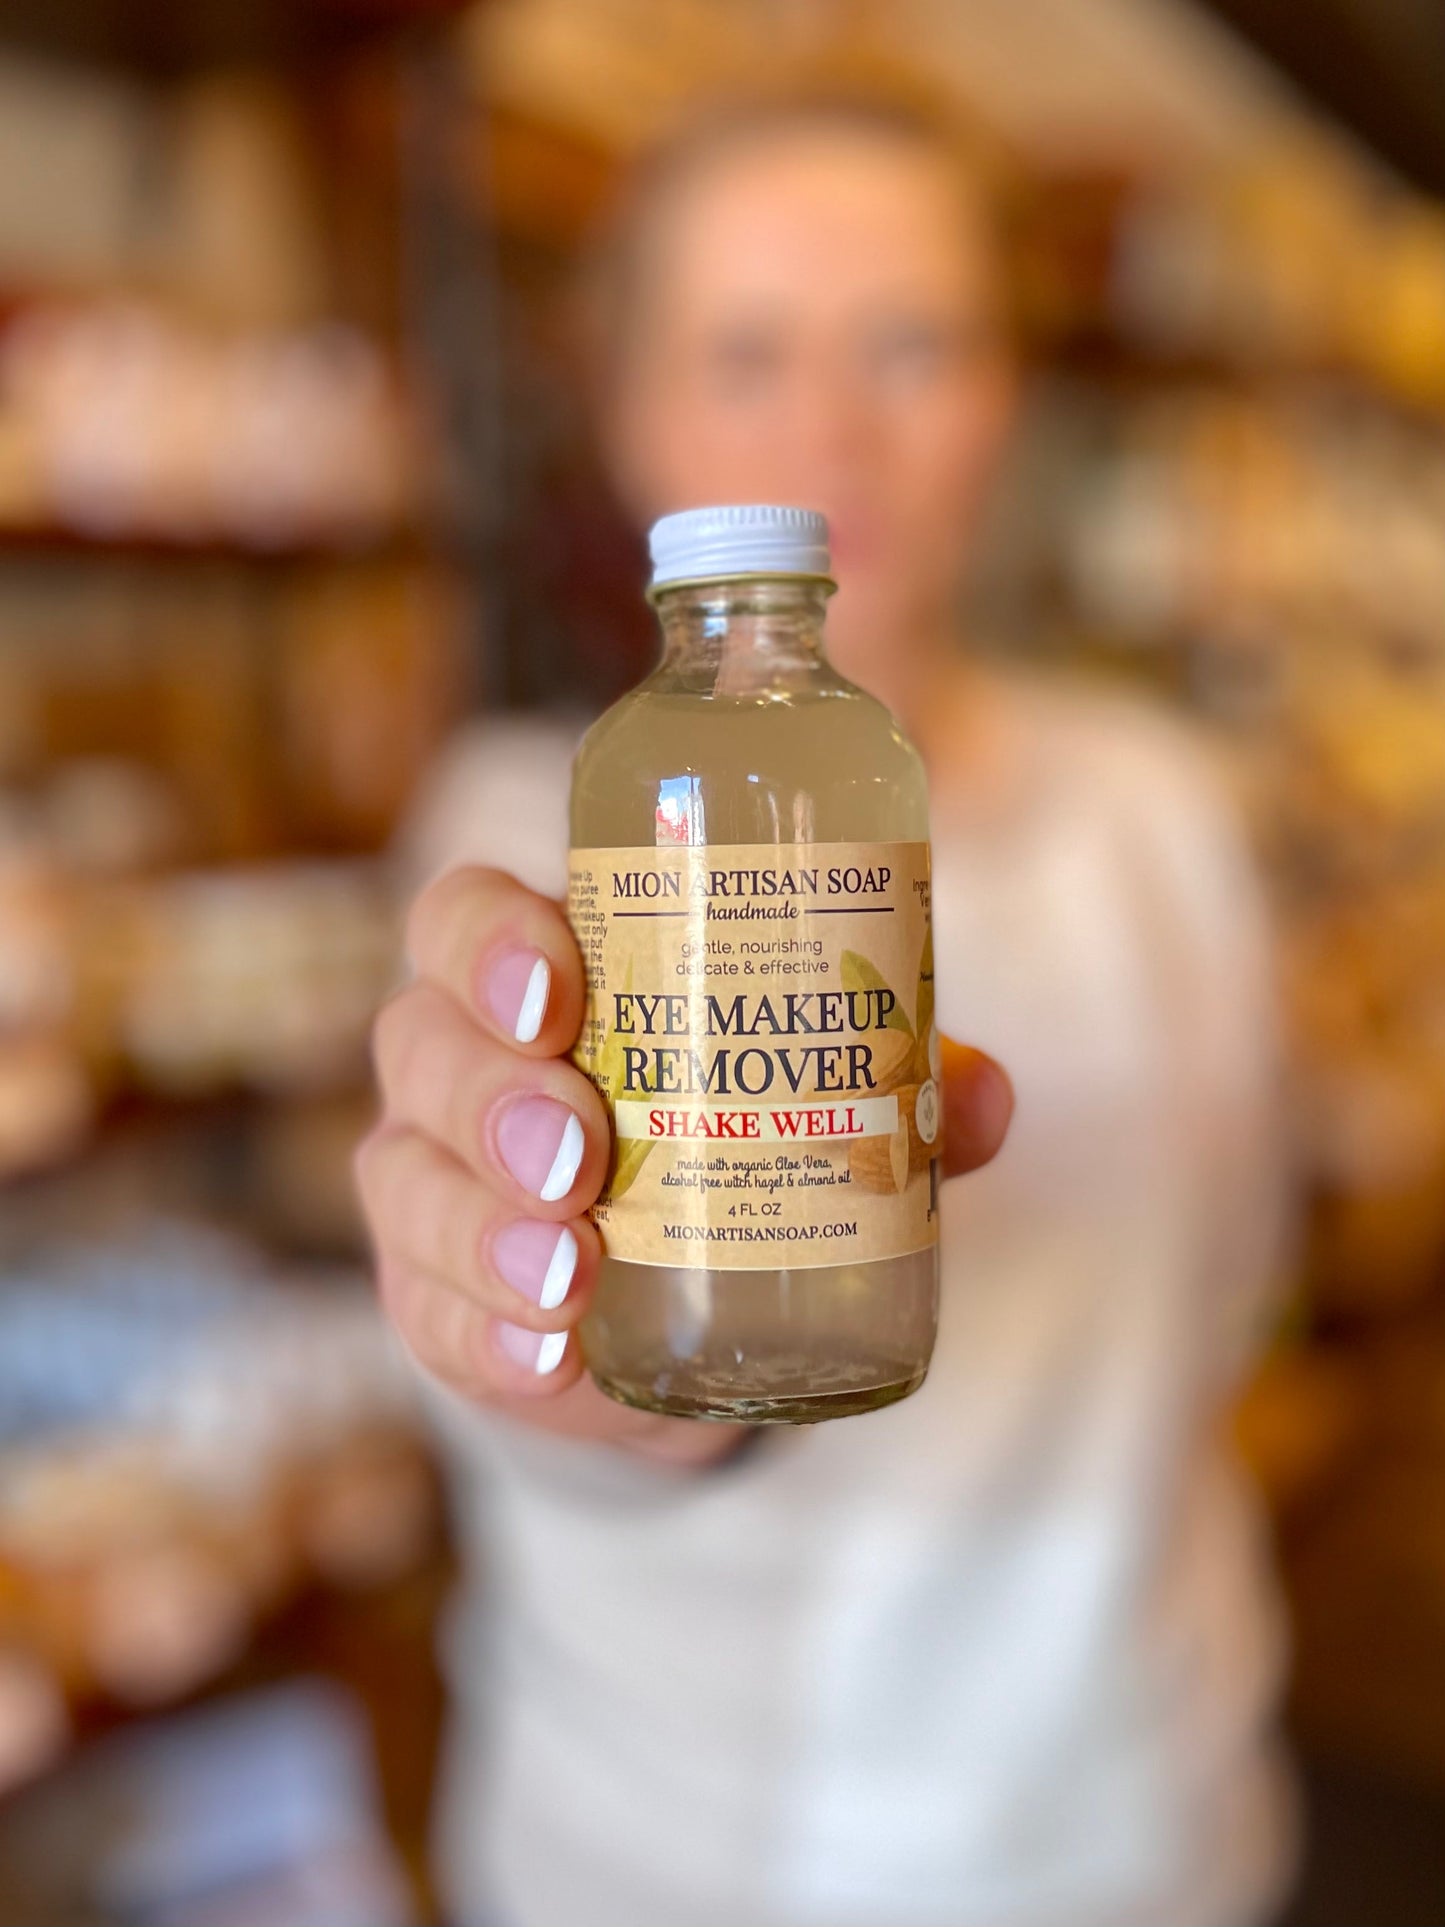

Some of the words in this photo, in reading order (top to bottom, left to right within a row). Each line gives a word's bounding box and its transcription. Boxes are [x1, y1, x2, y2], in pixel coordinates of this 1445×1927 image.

[613, 870, 681, 897] MION
[689, 869, 819, 897] ARTISAN
[827, 867, 891, 894] SOAP
[706, 901, 799, 920] handmade
[740, 938, 823, 957] nourishing
[744, 961, 756, 975] &
[758, 959, 829, 975] effective
[613, 992, 690, 1036] EYE
[704, 988, 896, 1037] MAKEUP
[622, 1044, 878, 1095] REMOVER
[649, 1109, 760, 1139] SHAKE
[769, 1107, 864, 1138] WELL
[677, 1157, 705, 1170] made
[707, 1157, 730, 1171] with
[732, 1158, 773, 1178] organic
[775, 1155, 800, 1170] Aloe
[803, 1154, 832, 1169] Vera,
[661, 1171, 698, 1187] alcohol
[698, 1173, 722, 1194] free
[724, 1174, 753, 1188] witch
[754, 1173, 784, 1195] hazel
[787, 1172, 794, 1187] &
[798, 1171, 836, 1187] almond
[838, 1169, 851, 1183] oil
[728, 1204, 736, 1218] 4
[740, 1203, 757, 1216] FL
[761, 1202, 782, 1216] OZ
[663, 1222, 857, 1242] MIONARTISANSOAP.COM
